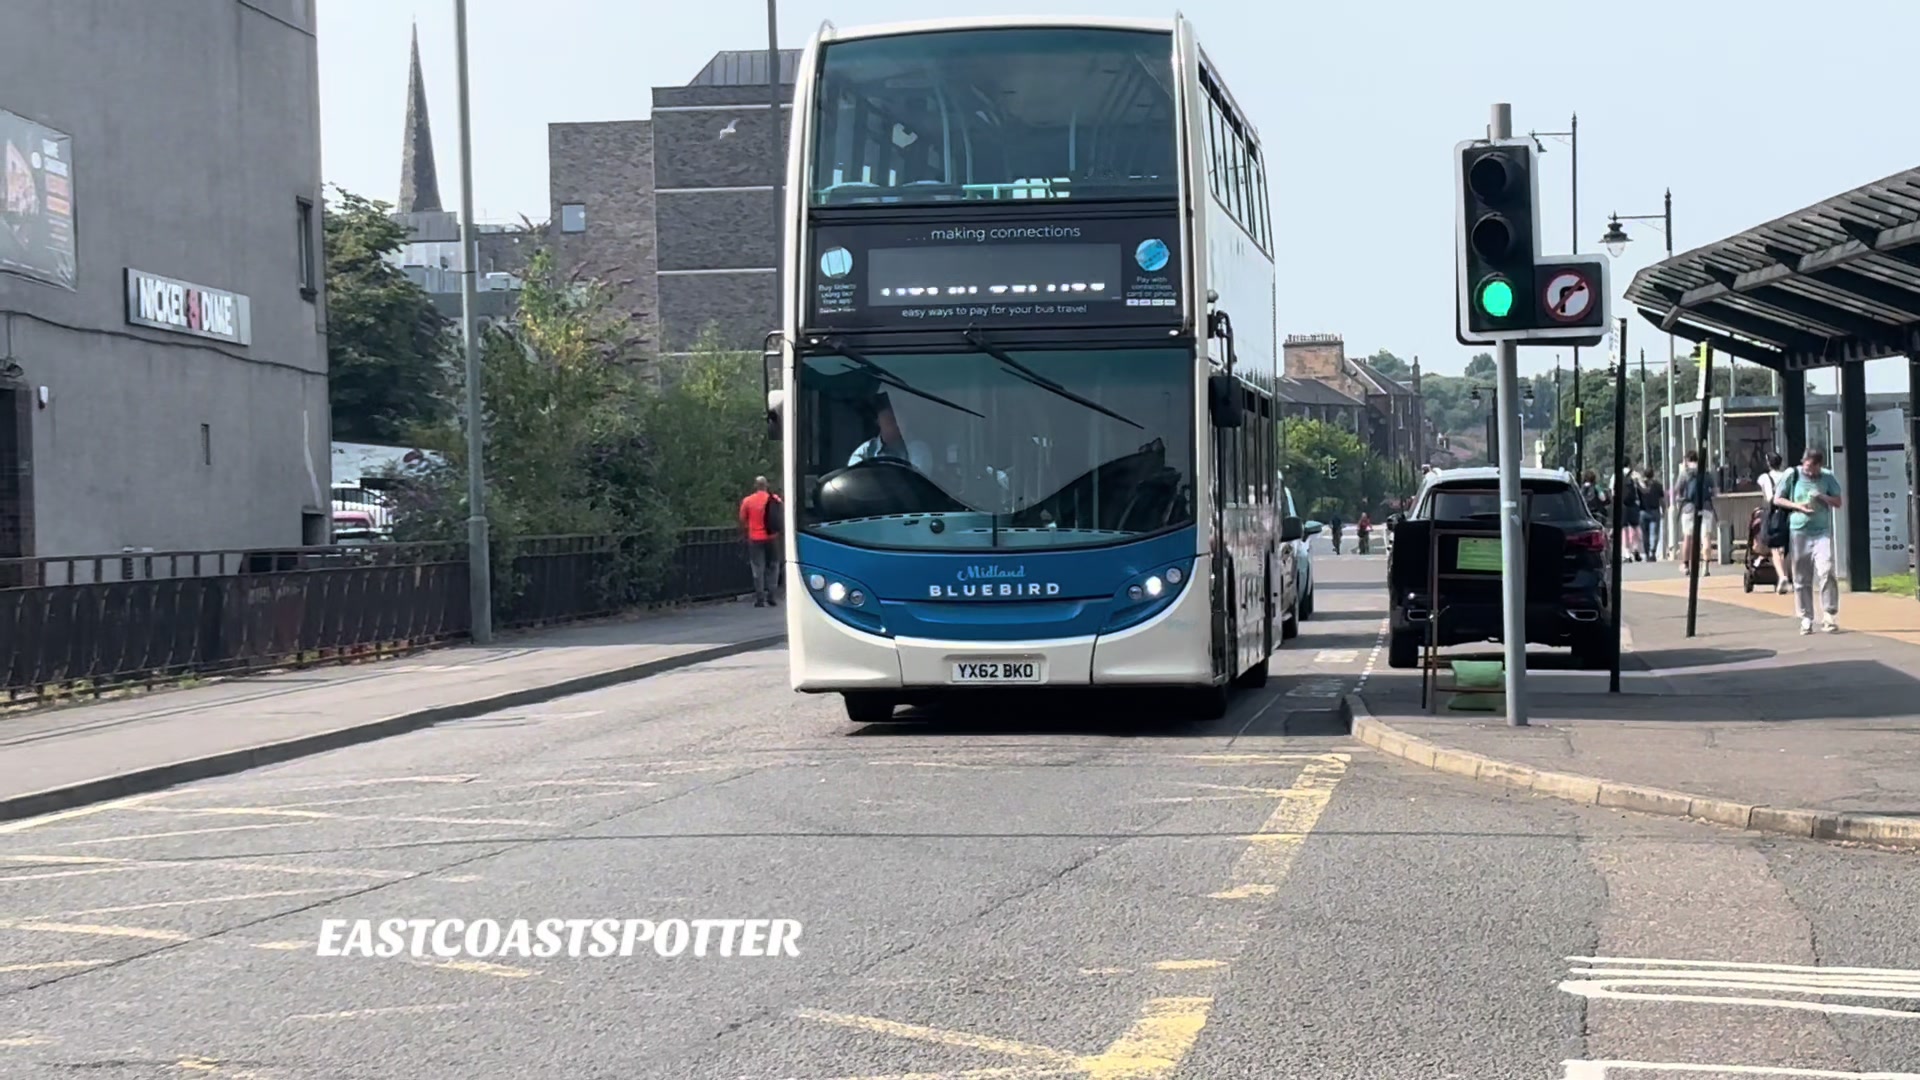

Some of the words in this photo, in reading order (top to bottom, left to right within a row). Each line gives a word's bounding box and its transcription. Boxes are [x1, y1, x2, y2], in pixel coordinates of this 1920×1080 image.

[931, 227, 985, 242] making
[990, 225, 1081, 239] connections
[139, 276, 188, 327] NICKEL
[201, 291, 233, 335] DIME
[902, 308, 925, 319] easy
[928, 307, 954, 318] ways
[956, 306, 968, 316] to
[969, 307, 990, 317] pay
[991, 304, 1005, 315] for
[1008, 306, 1033, 316] your
[1035, 304, 1055, 314] bus
[1057, 304, 1087, 314] travel
[957, 565, 1026, 581] Midland
[929, 583, 1060, 597] BLUEBIRD
[958, 663, 999, 679] YX62
[1002, 663, 1033, 679] BKO
